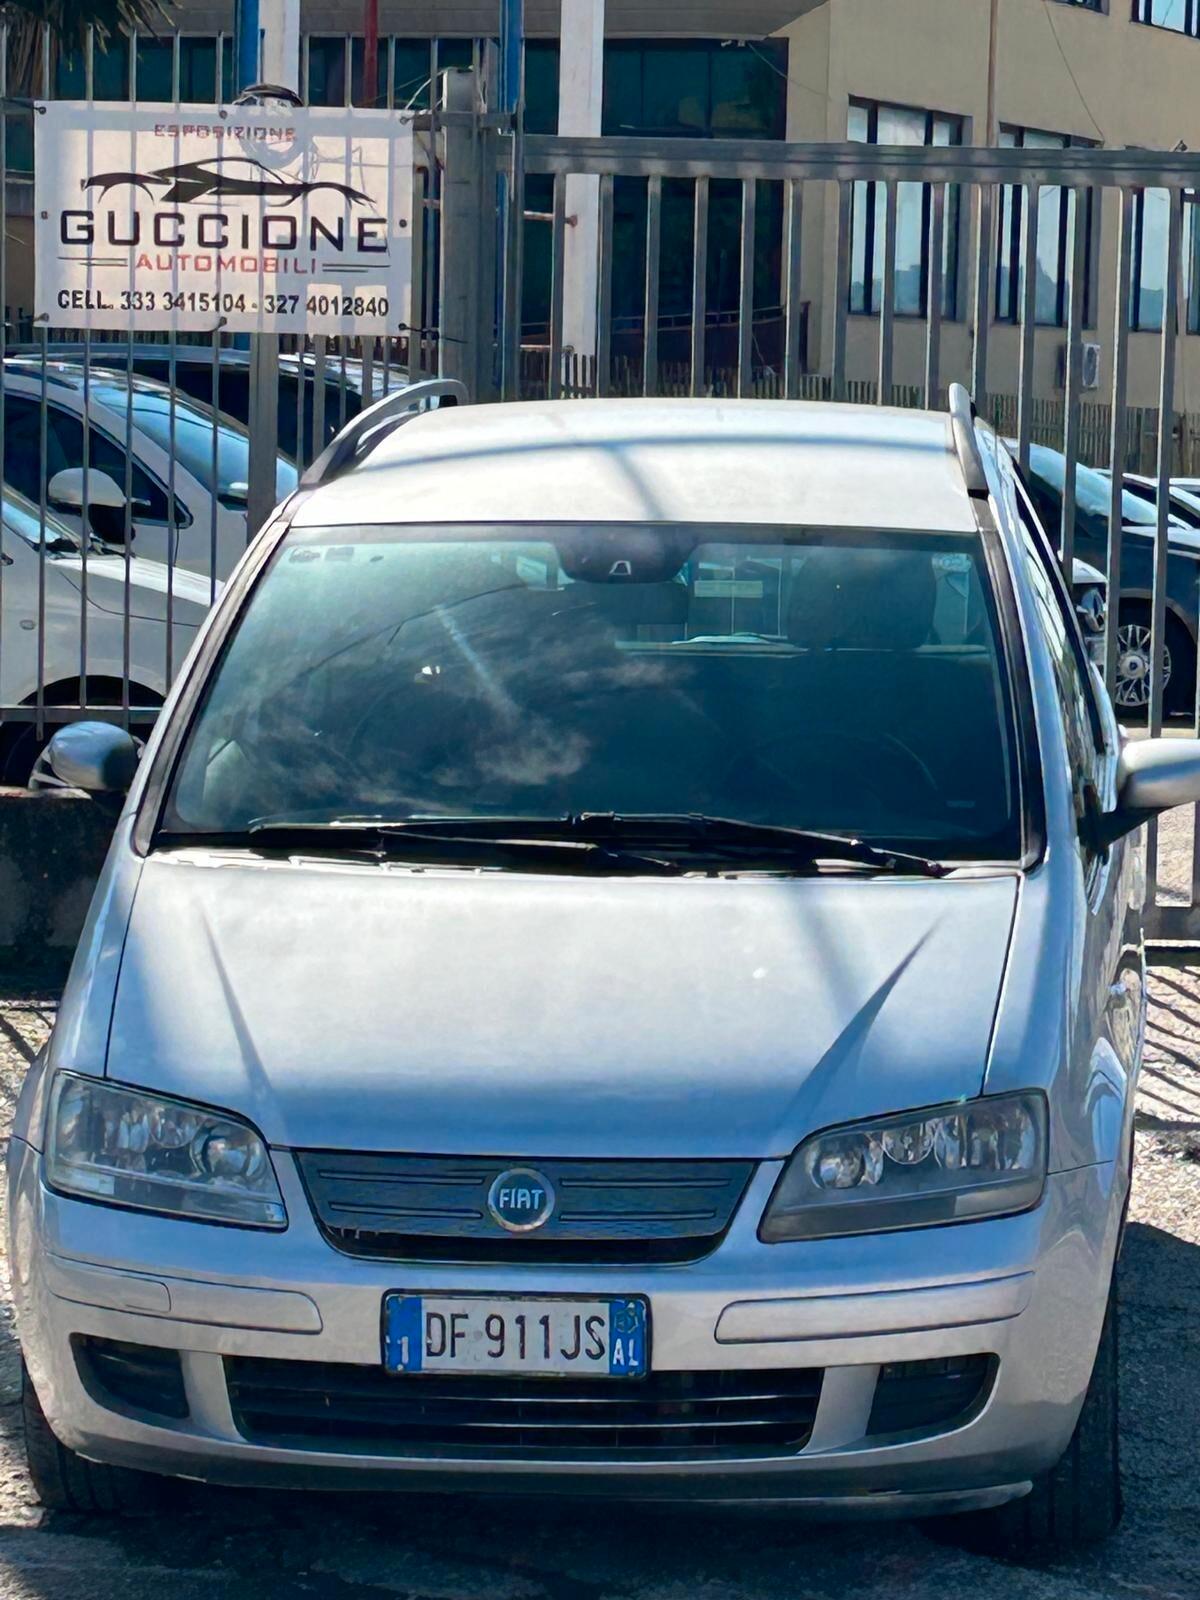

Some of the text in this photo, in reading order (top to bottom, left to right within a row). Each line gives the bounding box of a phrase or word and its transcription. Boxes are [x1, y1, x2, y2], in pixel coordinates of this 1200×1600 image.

[154, 124, 297, 142] ESPOSIZIONE
[60, 210, 388, 253] GUCCIONE
[135, 253, 316, 275] AUTOMOBILI
[57, 289, 114, 310] CELL.
[120, 290, 155, 311] 333
[163, 291, 246, 313] 3415104
[264, 294, 299, 314] 327
[306, 295, 389, 317] 4012840
[500, 1188, 544, 1210] FIAT
[426, 1312, 469, 1358] DF
[612, 1338, 639, 1367] AL
